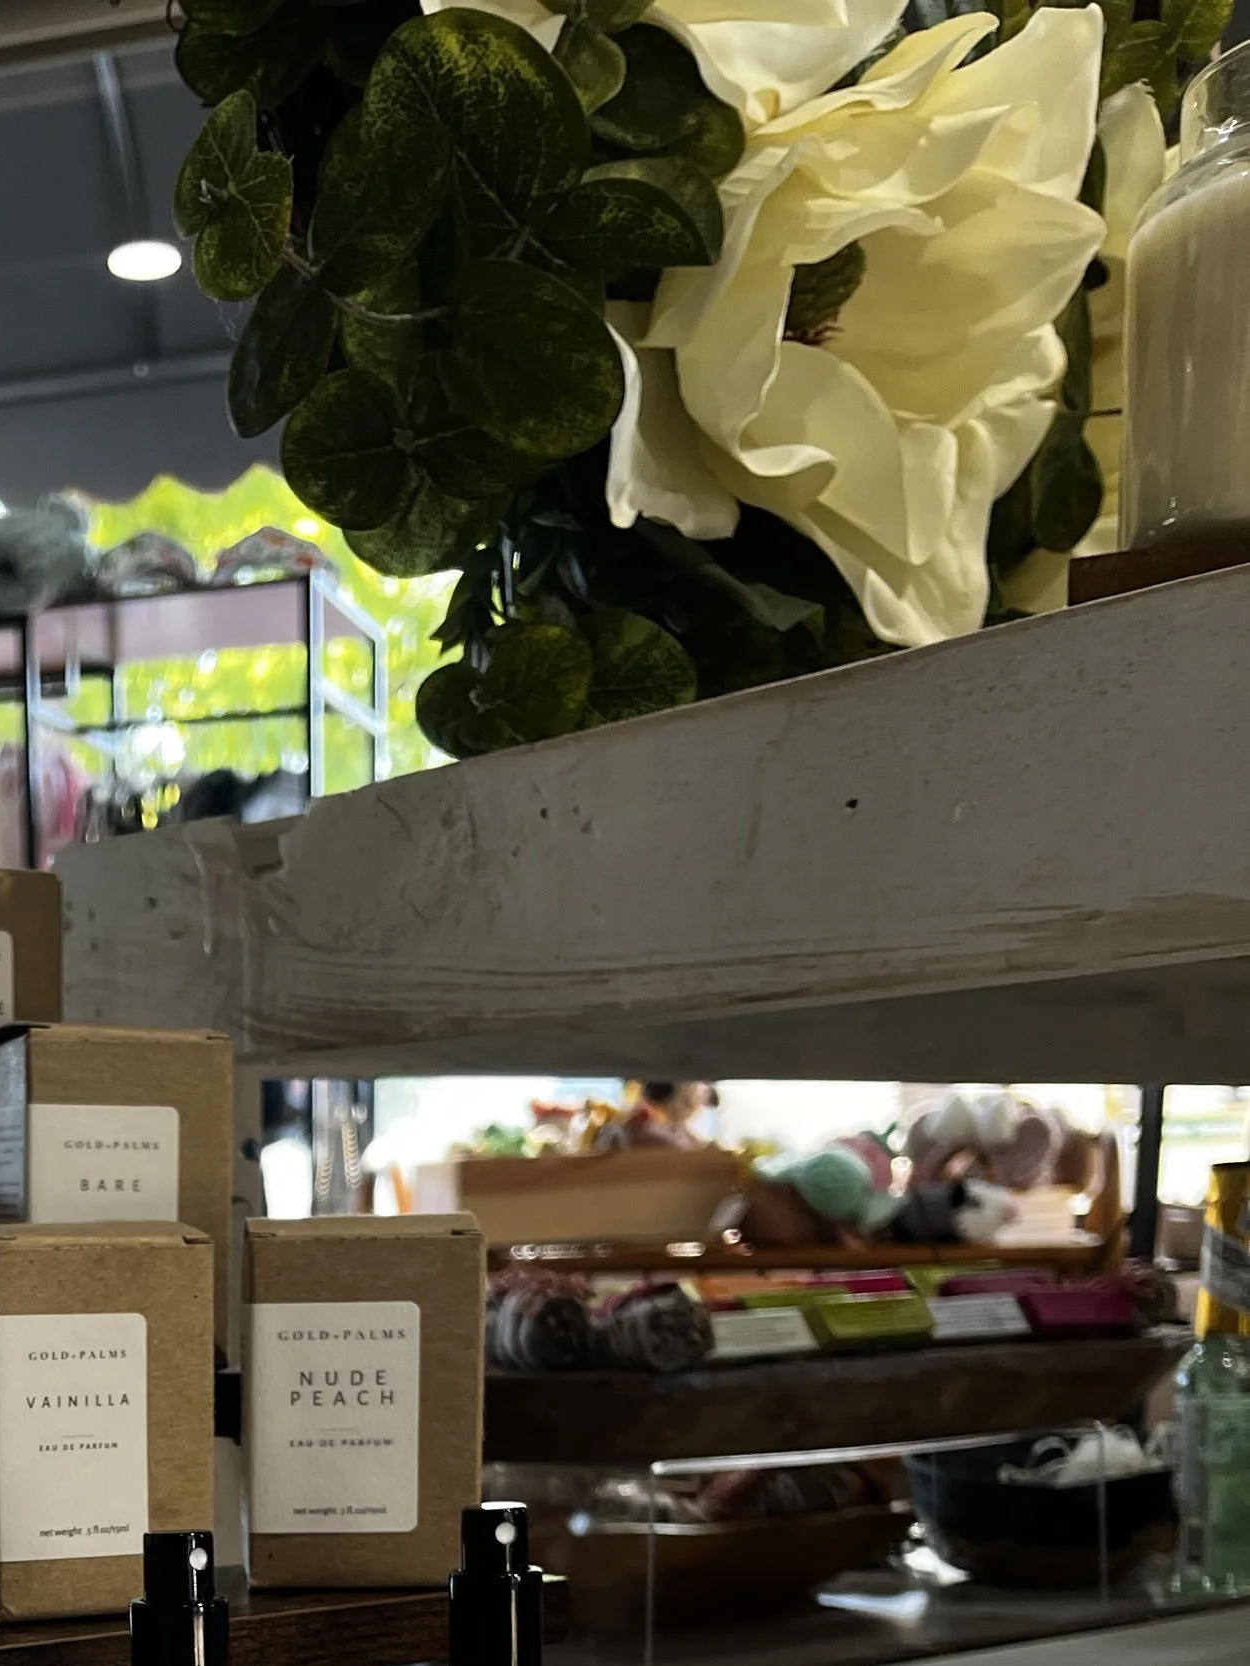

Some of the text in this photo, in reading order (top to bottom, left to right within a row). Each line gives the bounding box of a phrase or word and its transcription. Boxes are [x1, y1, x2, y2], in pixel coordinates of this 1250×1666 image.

[80, 1178, 142, 1192] BARE
[299, 1370, 387, 1386] NUDE
[26, 1393, 130, 1409] VAINILLA
[290, 1389, 395, 1406] PEACH
[39, 1444, 58, 1452] EAU
[79, 1442, 119, 1450] PARFUM
